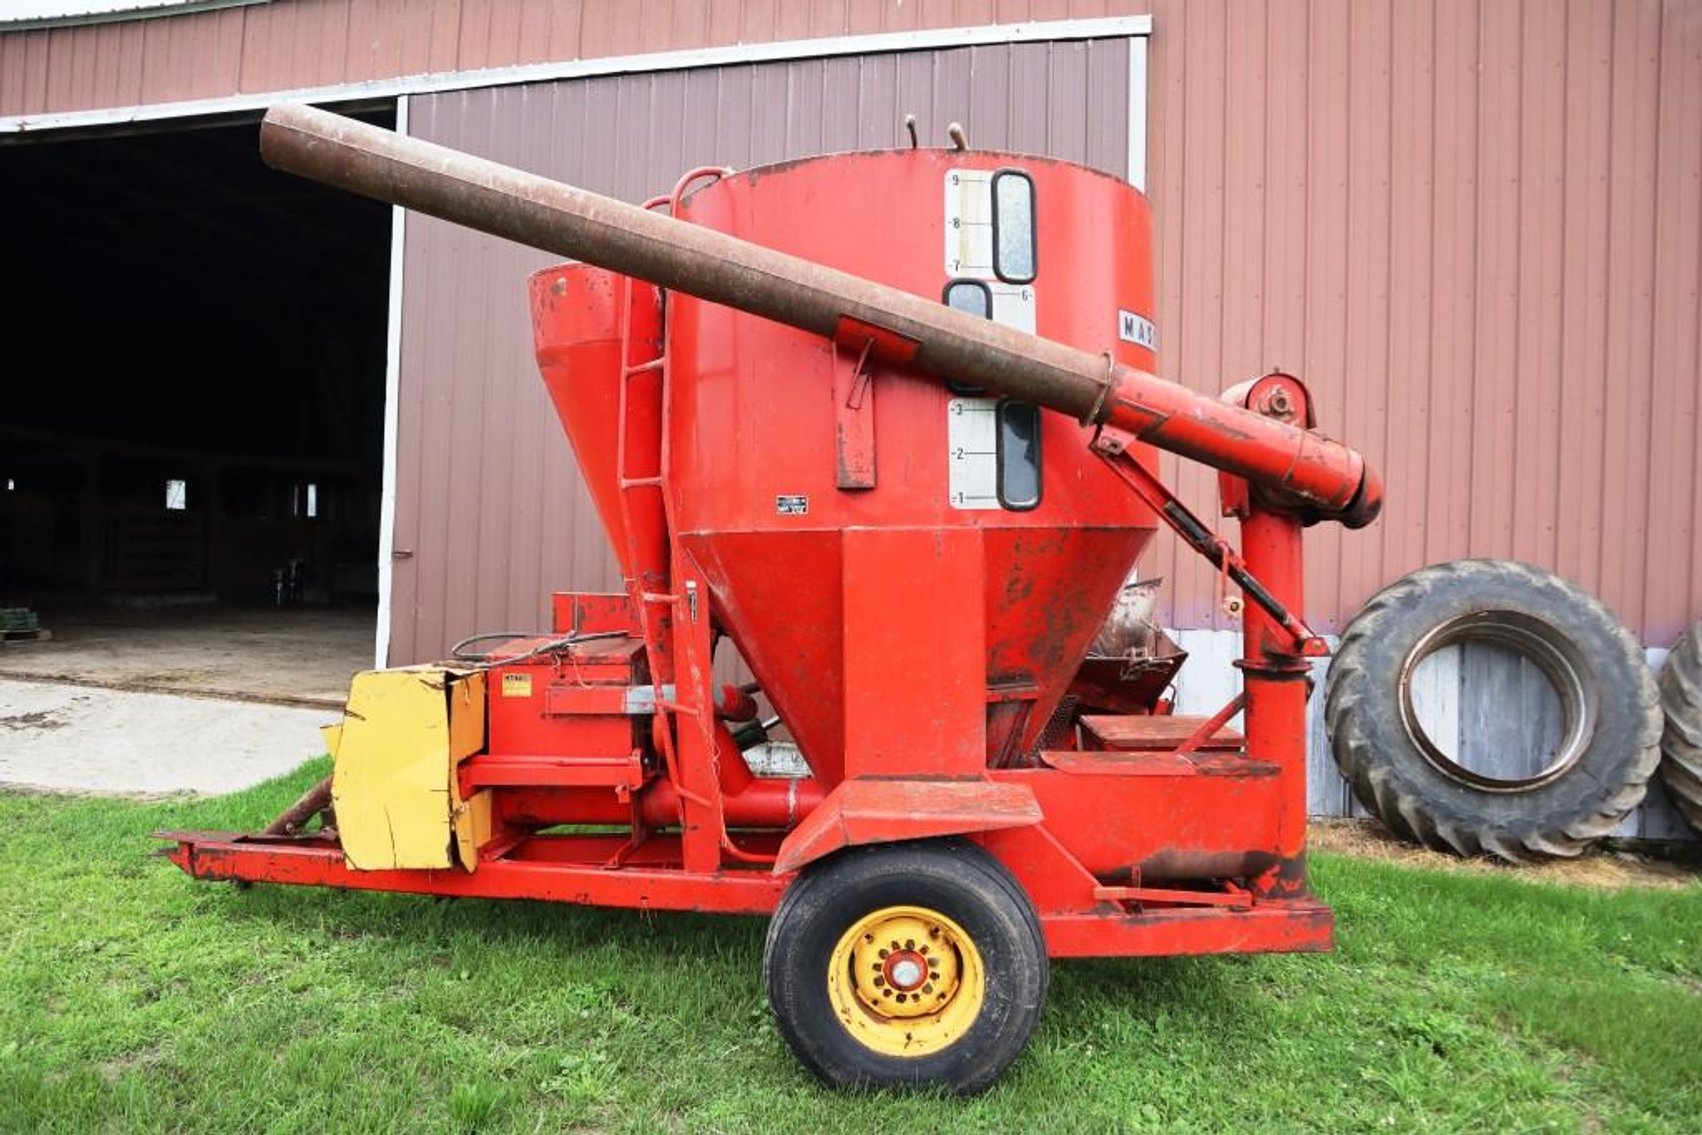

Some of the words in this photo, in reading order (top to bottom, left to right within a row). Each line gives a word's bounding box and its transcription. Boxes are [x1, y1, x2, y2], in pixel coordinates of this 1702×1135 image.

[952, 174, 959, 186] 9
[953, 217, 960, 229] 8
[953, 259, 960, 272] 7
[1021, 287, 1028, 301] 6
[956, 403, 963, 416] 3
[957, 447, 964, 460] 2
[958, 491, 964, 504] 1
